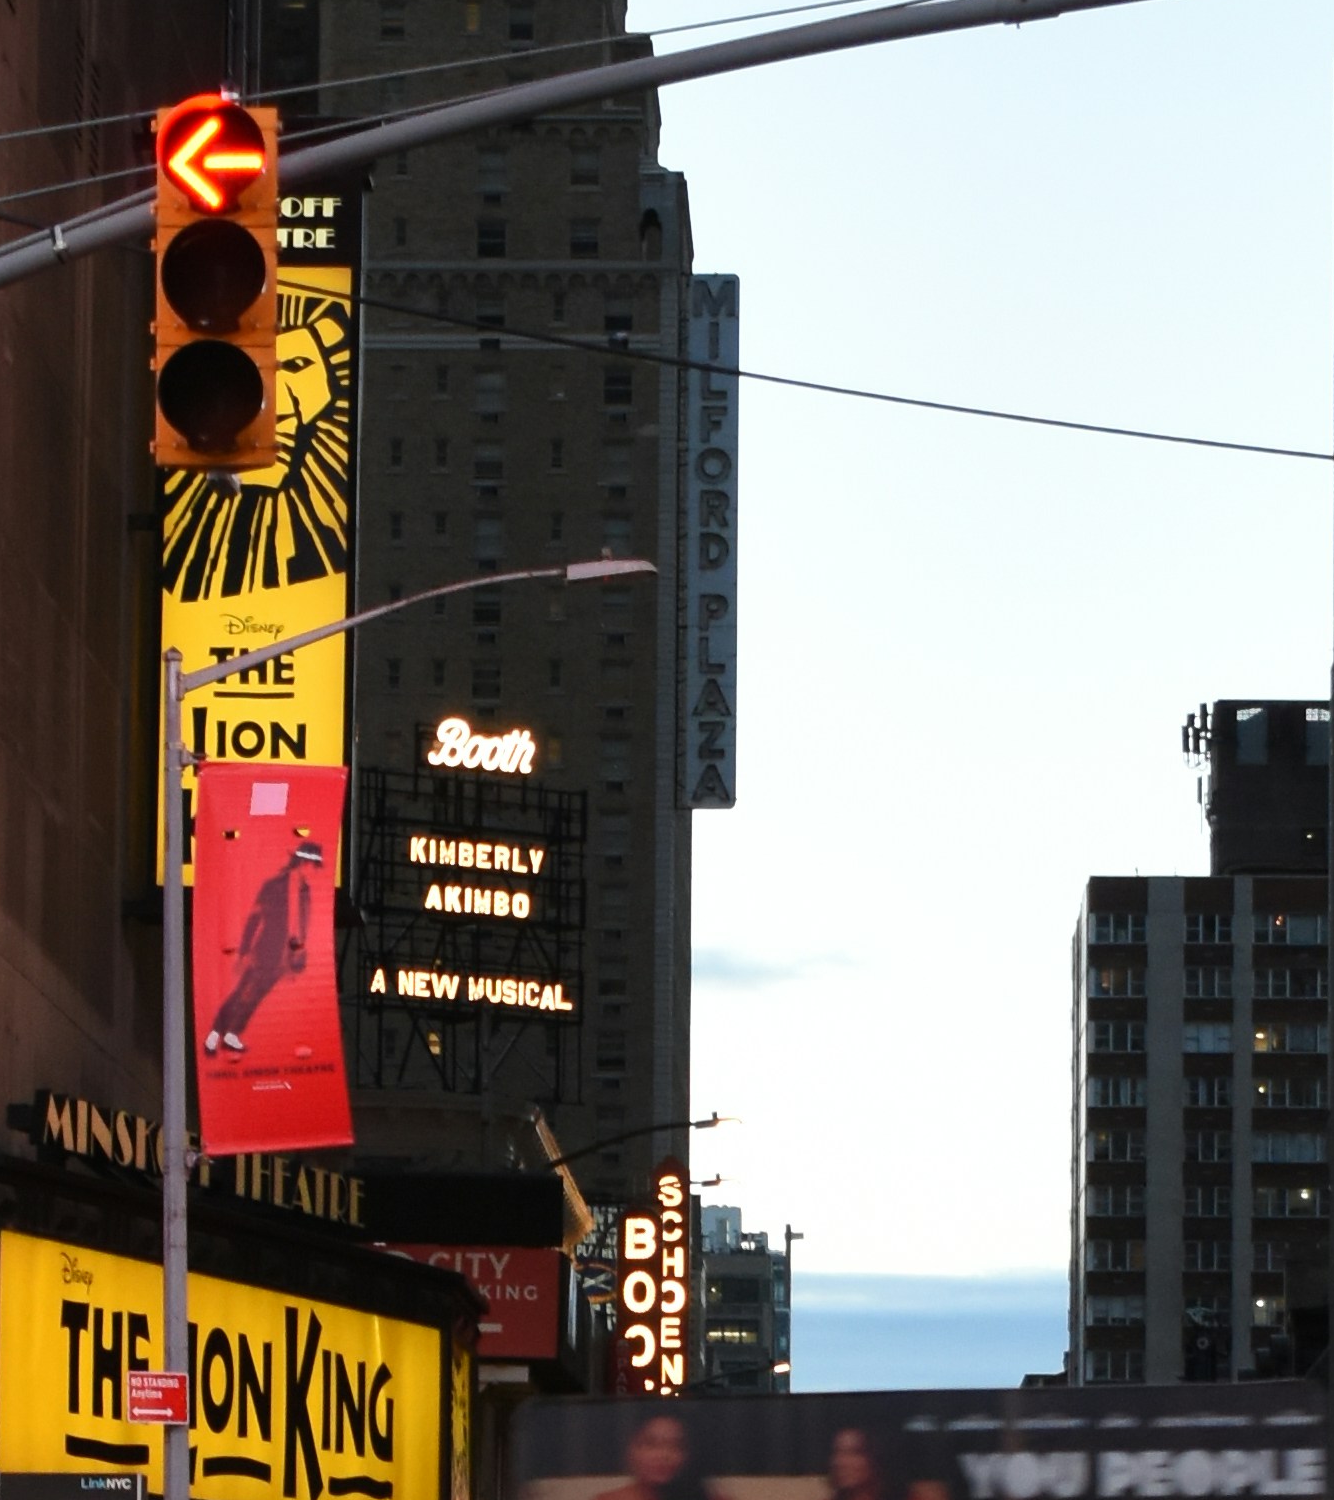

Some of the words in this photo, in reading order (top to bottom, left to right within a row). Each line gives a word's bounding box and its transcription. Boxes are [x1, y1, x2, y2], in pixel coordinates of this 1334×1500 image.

[692, 280, 736, 572] MILFORD
[209, 646, 296, 686] THE
[691, 593, 733, 801] PLAZA
[427, 717, 537, 775] Booth
[410, 836, 545, 875] KIMBERLY
[424, 884, 531, 919] AKIMBO
[370, 968, 386, 994] A
[398, 970, 461, 1000] NEW
[468, 976, 573, 1012] MUSICAL
[657, 1175, 686, 1396] SCHOEN
[131, 1376, 142, 1387] NO
[144, 1377, 180, 1389] STANDING
[188, 1321, 273, 1443] ION
[80, 1477, 132, 1490] LinkNYC
[956, 1451, 1091, 1500] YOU
[1095, 1448, 1327, 1498] PEOPLE
